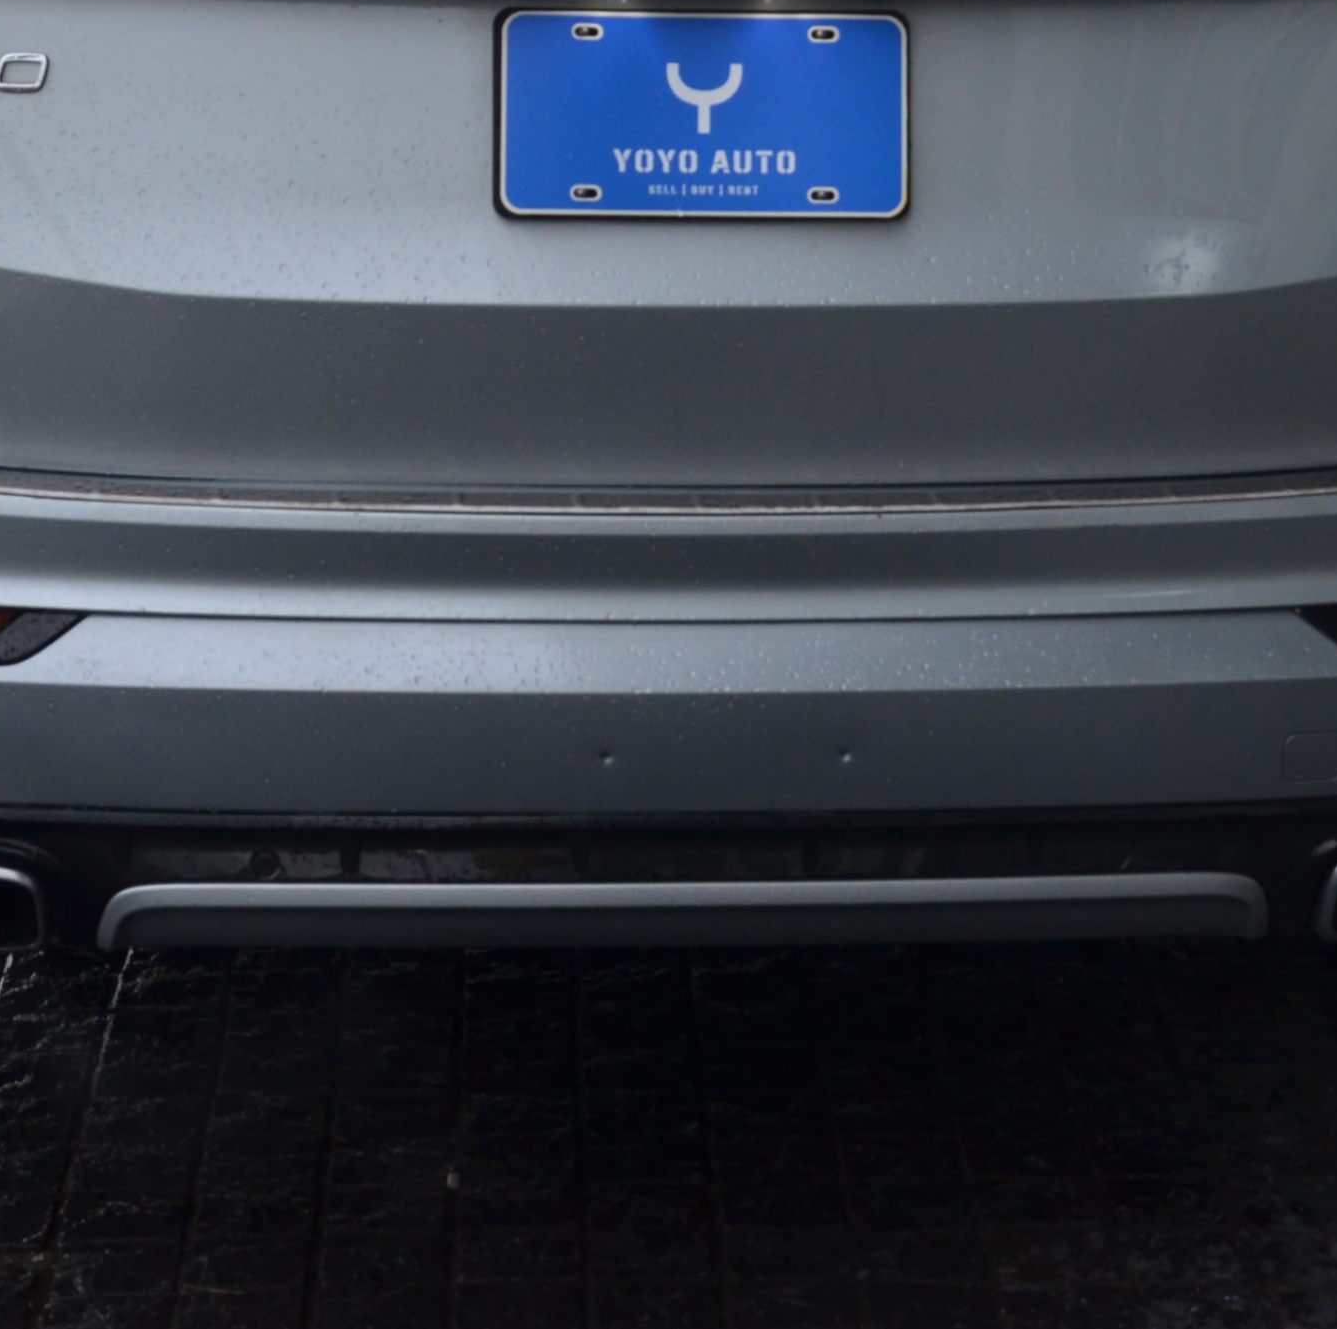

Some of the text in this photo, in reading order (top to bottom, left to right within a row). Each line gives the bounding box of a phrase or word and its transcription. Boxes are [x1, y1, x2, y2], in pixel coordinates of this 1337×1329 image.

[613, 148, 796, 174] YOYO AUTO
[648, 184, 677, 196] SELL
[690, 184, 714, 196] BUY
[727, 185, 759, 196] RENT
